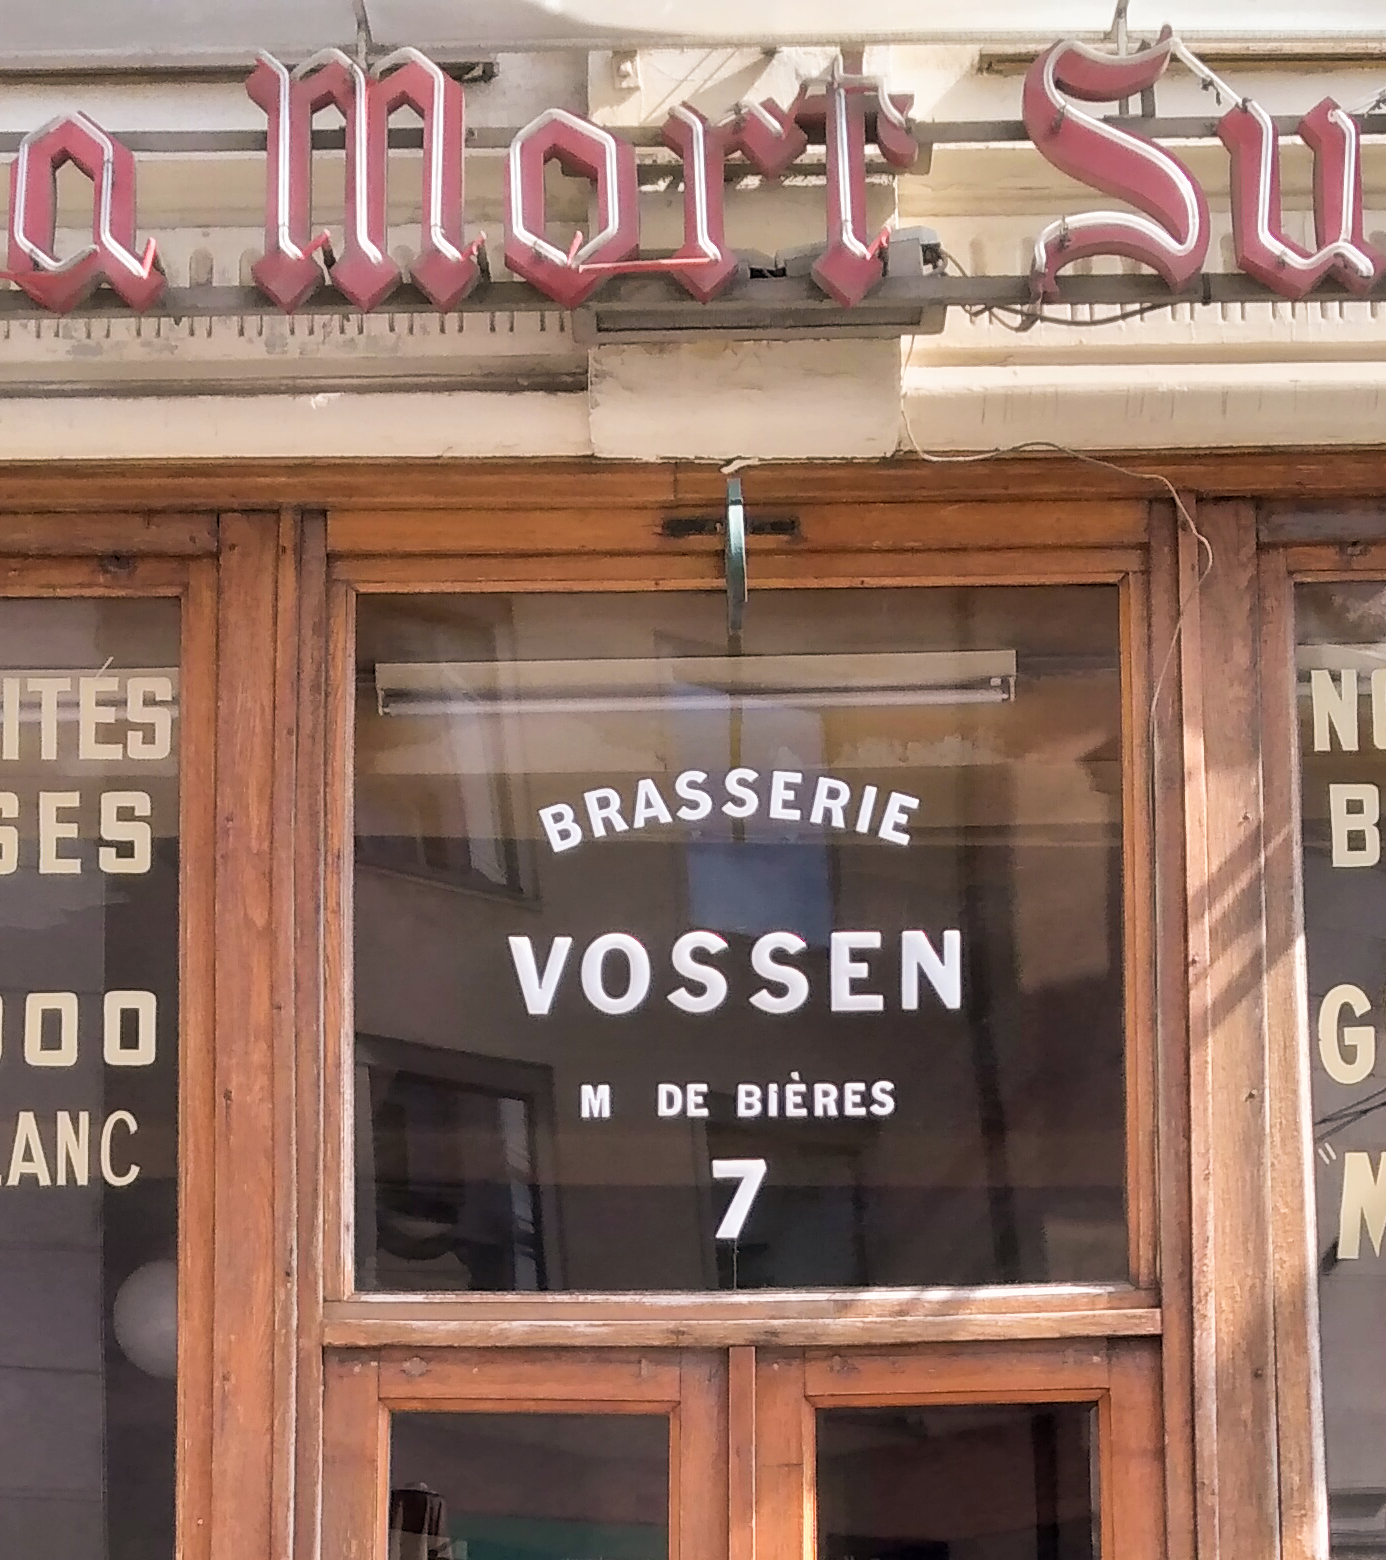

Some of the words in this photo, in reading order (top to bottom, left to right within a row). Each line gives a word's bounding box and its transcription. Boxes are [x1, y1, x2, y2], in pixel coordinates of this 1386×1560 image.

[247, 46, 918, 313] Mort
[538, 767, 921, 854] BRASSERIE
[508, 928, 961, 1016] VOSSEN
[580, 1083, 611, 1119] M
[657, 1083, 710, 1118] DE
[736, 1071, 896, 1119] BIÈRES
[711, 1158, 768, 1241] 7
